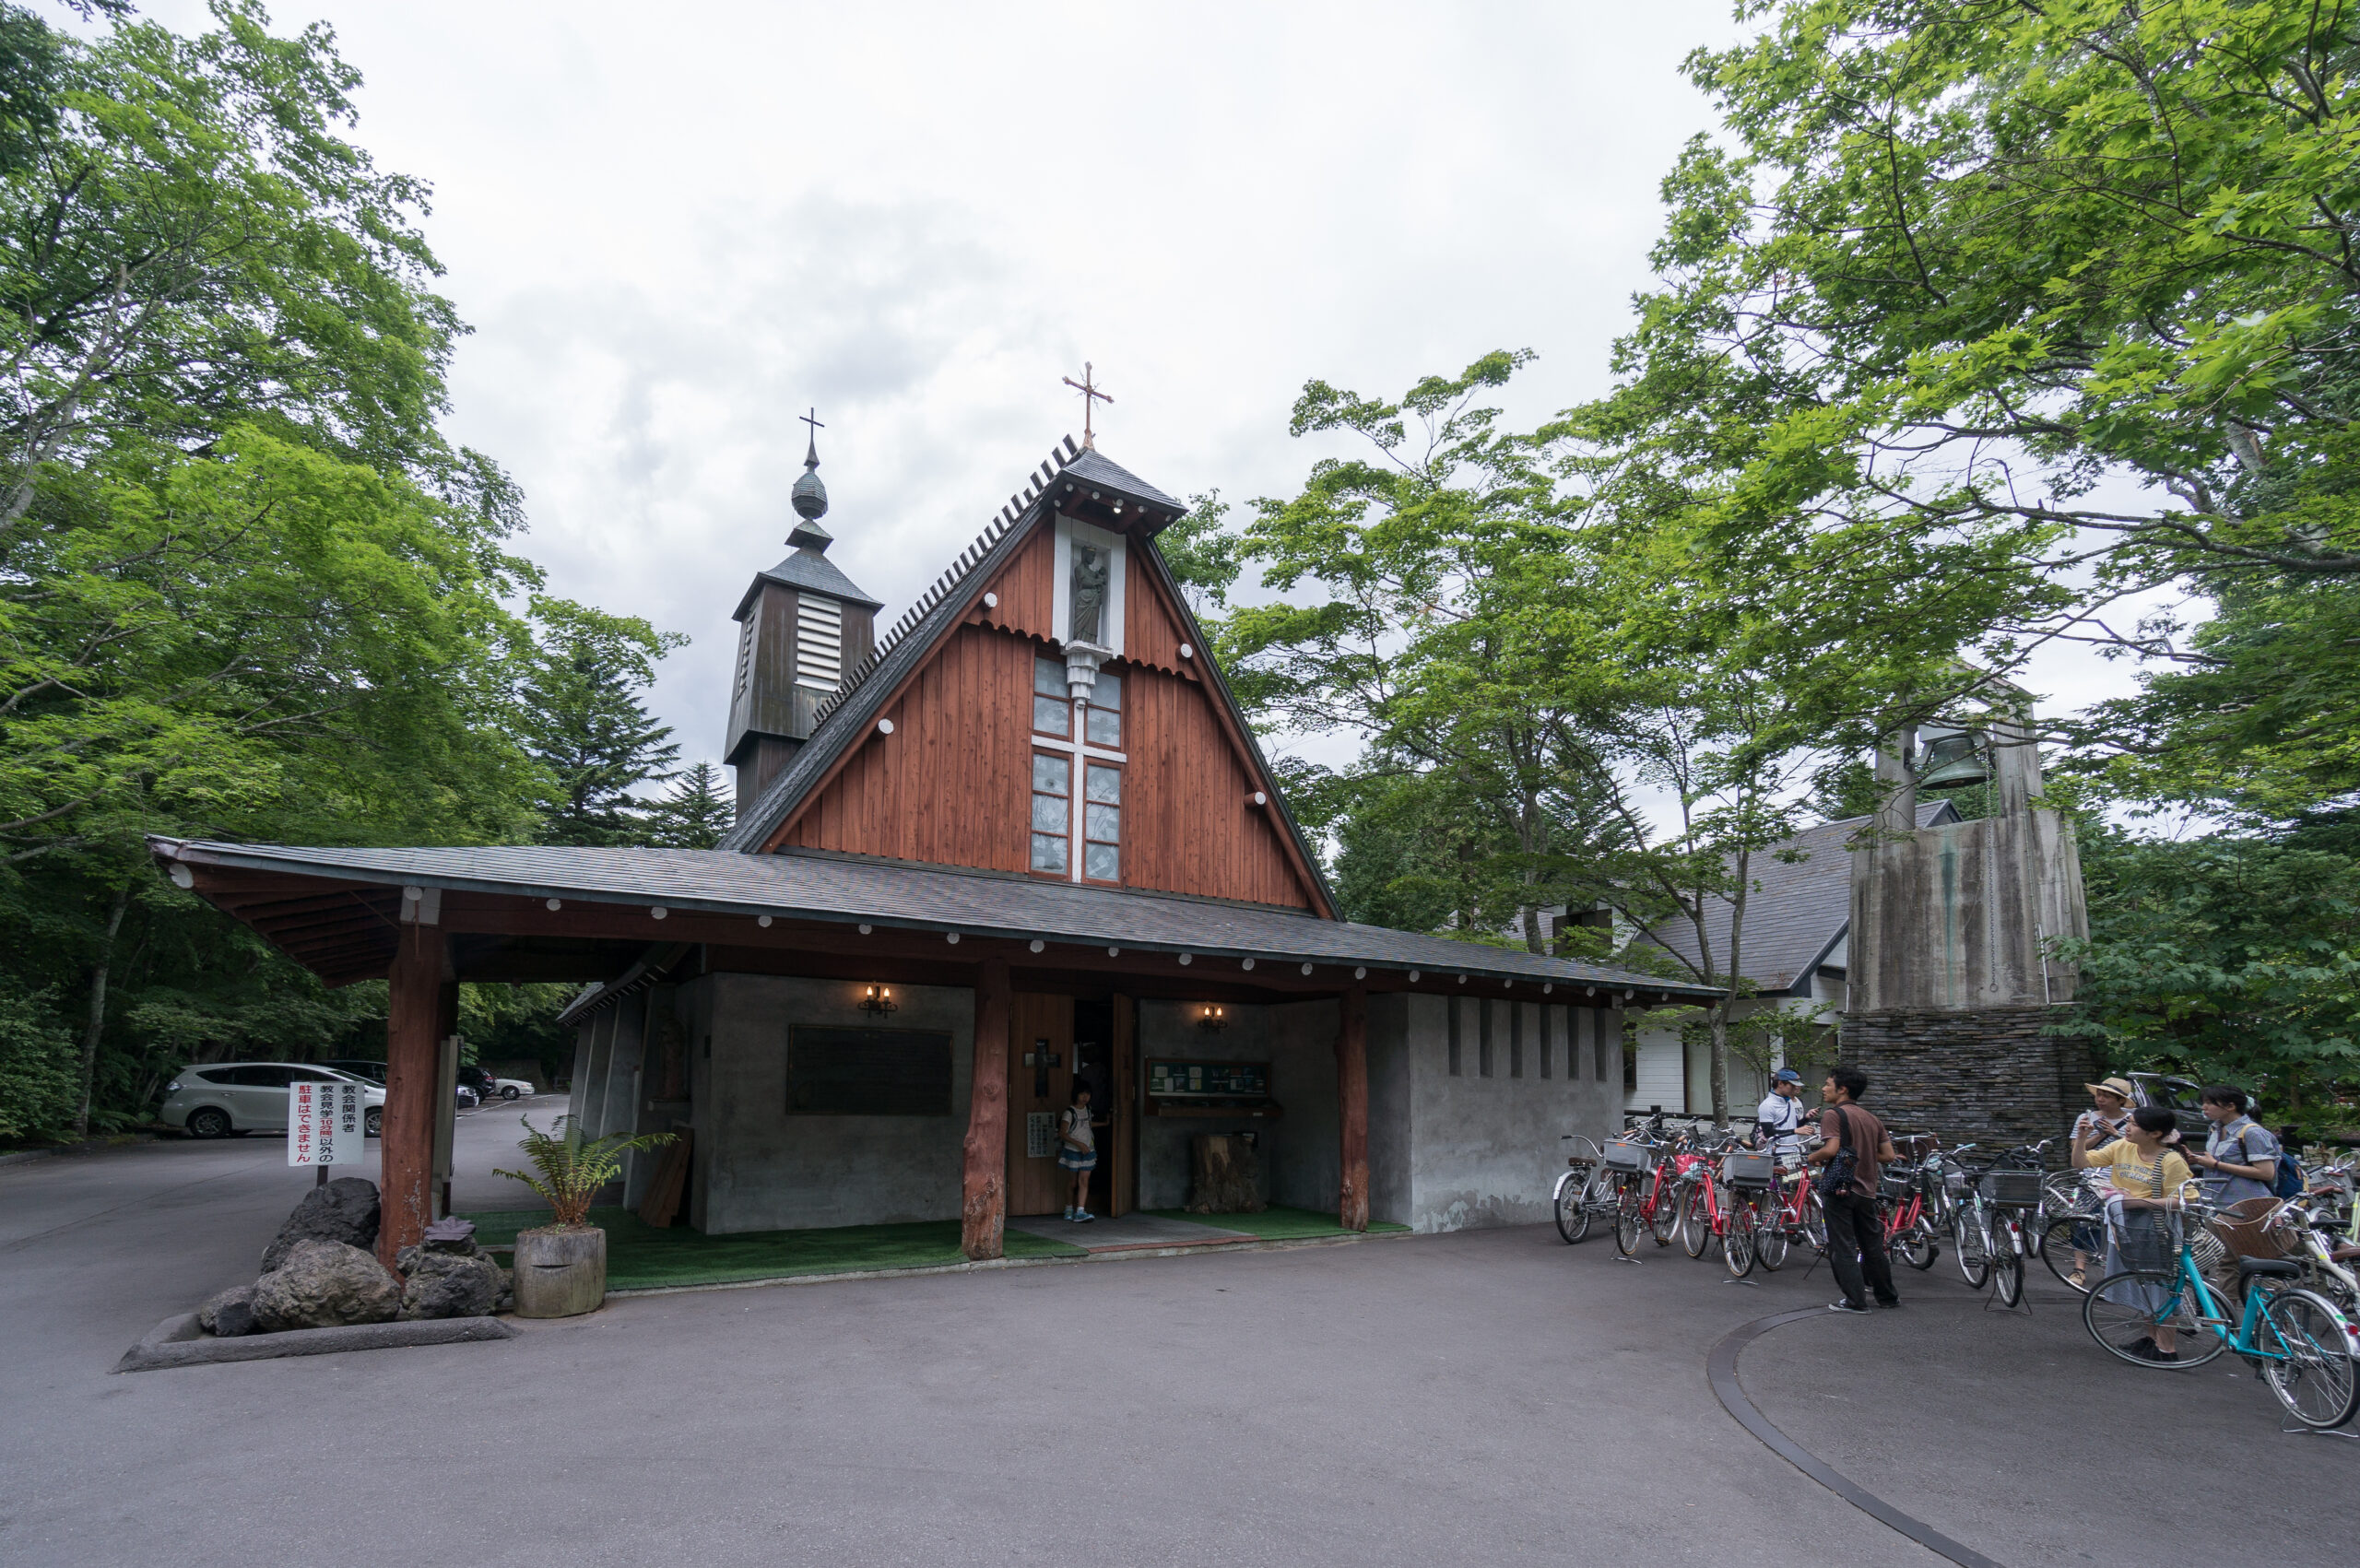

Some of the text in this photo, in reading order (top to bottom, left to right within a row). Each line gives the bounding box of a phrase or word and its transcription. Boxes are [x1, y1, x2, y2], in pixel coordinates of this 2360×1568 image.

[297, 1085, 312, 1163] 駐車はできません
[342, 1085, 356, 1133] 教会関係者
